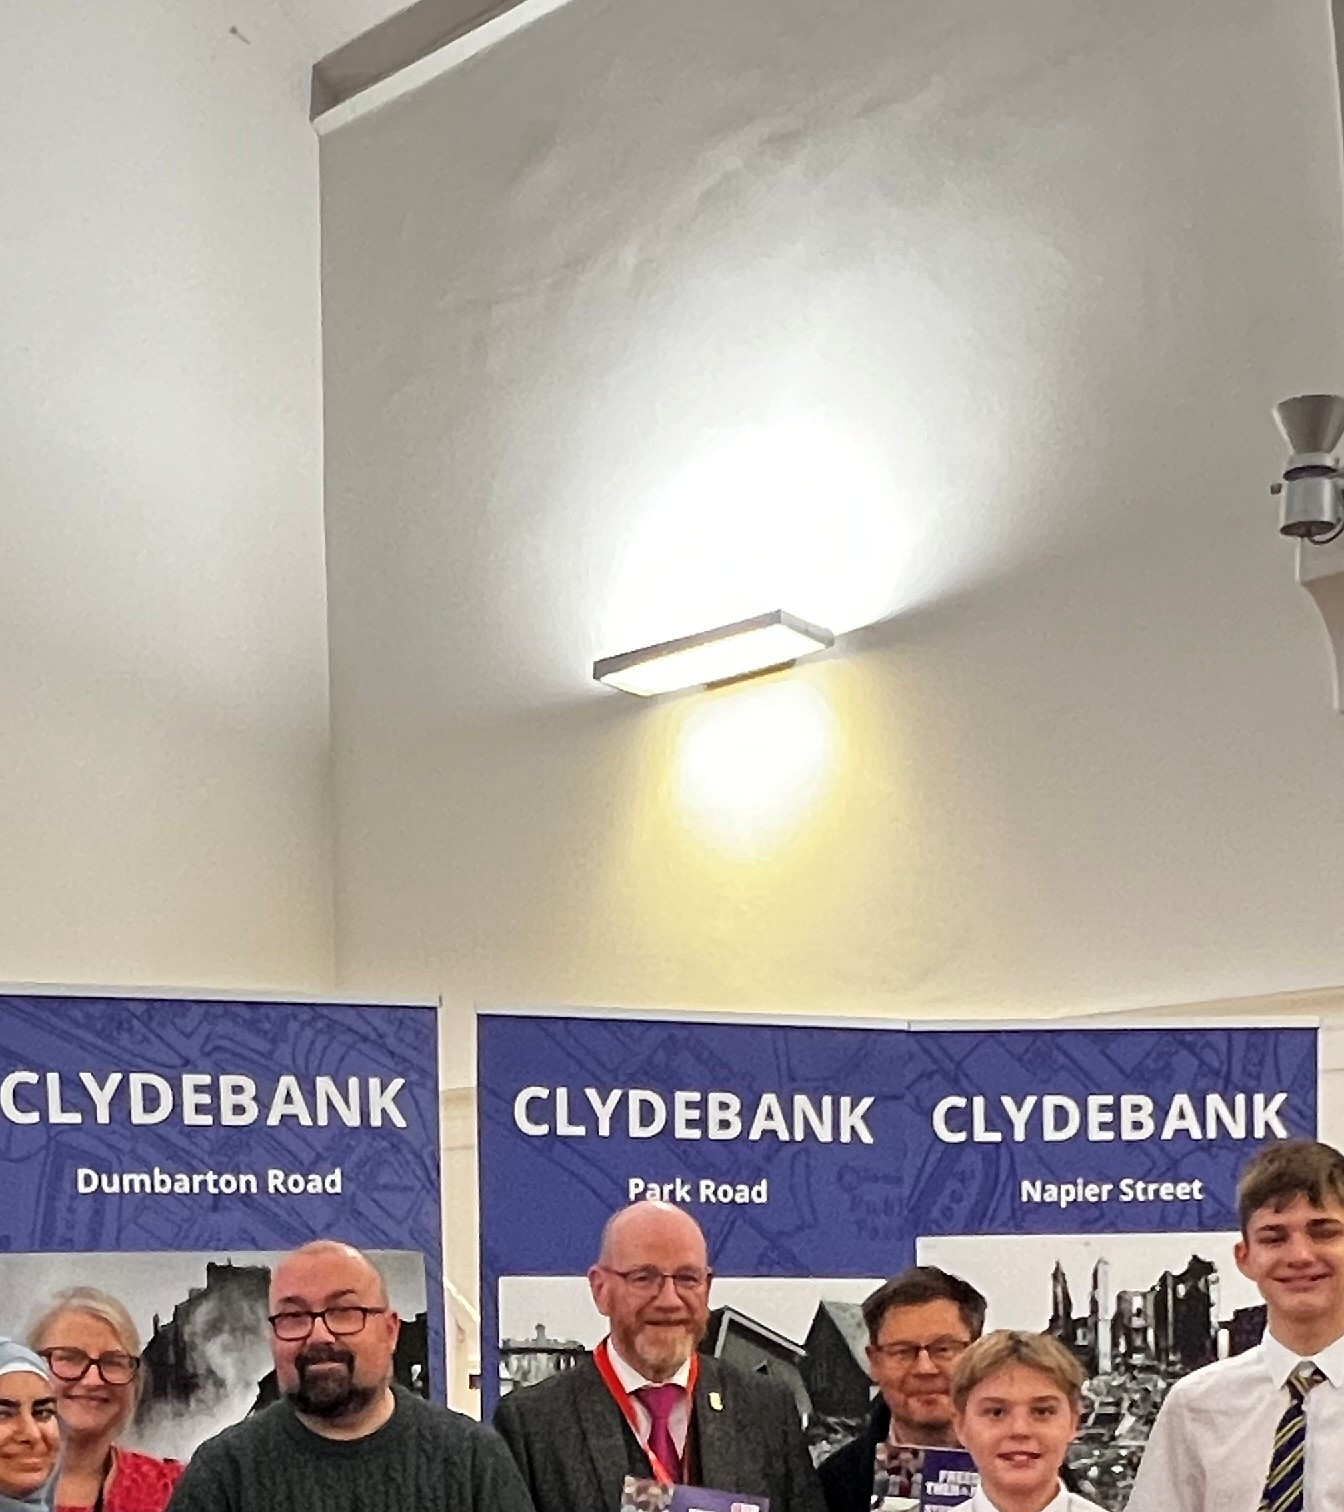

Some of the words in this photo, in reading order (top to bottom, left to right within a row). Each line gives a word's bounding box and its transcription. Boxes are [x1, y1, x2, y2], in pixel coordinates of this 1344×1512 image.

[0, 1070, 408, 1128] CLYDEBANK
[514, 1086, 875, 1145] CLYDEBANK
[932, 1093, 1288, 1143] CLYDEBANK
[76, 1166, 258, 1194] Dumbarton
[267, 1166, 343, 1194] Road
[628, 1177, 692, 1202] Park
[699, 1178, 768, 1204] Road
[1020, 1176, 1114, 1208] Napier
[1118, 1178, 1205, 1202] Street
